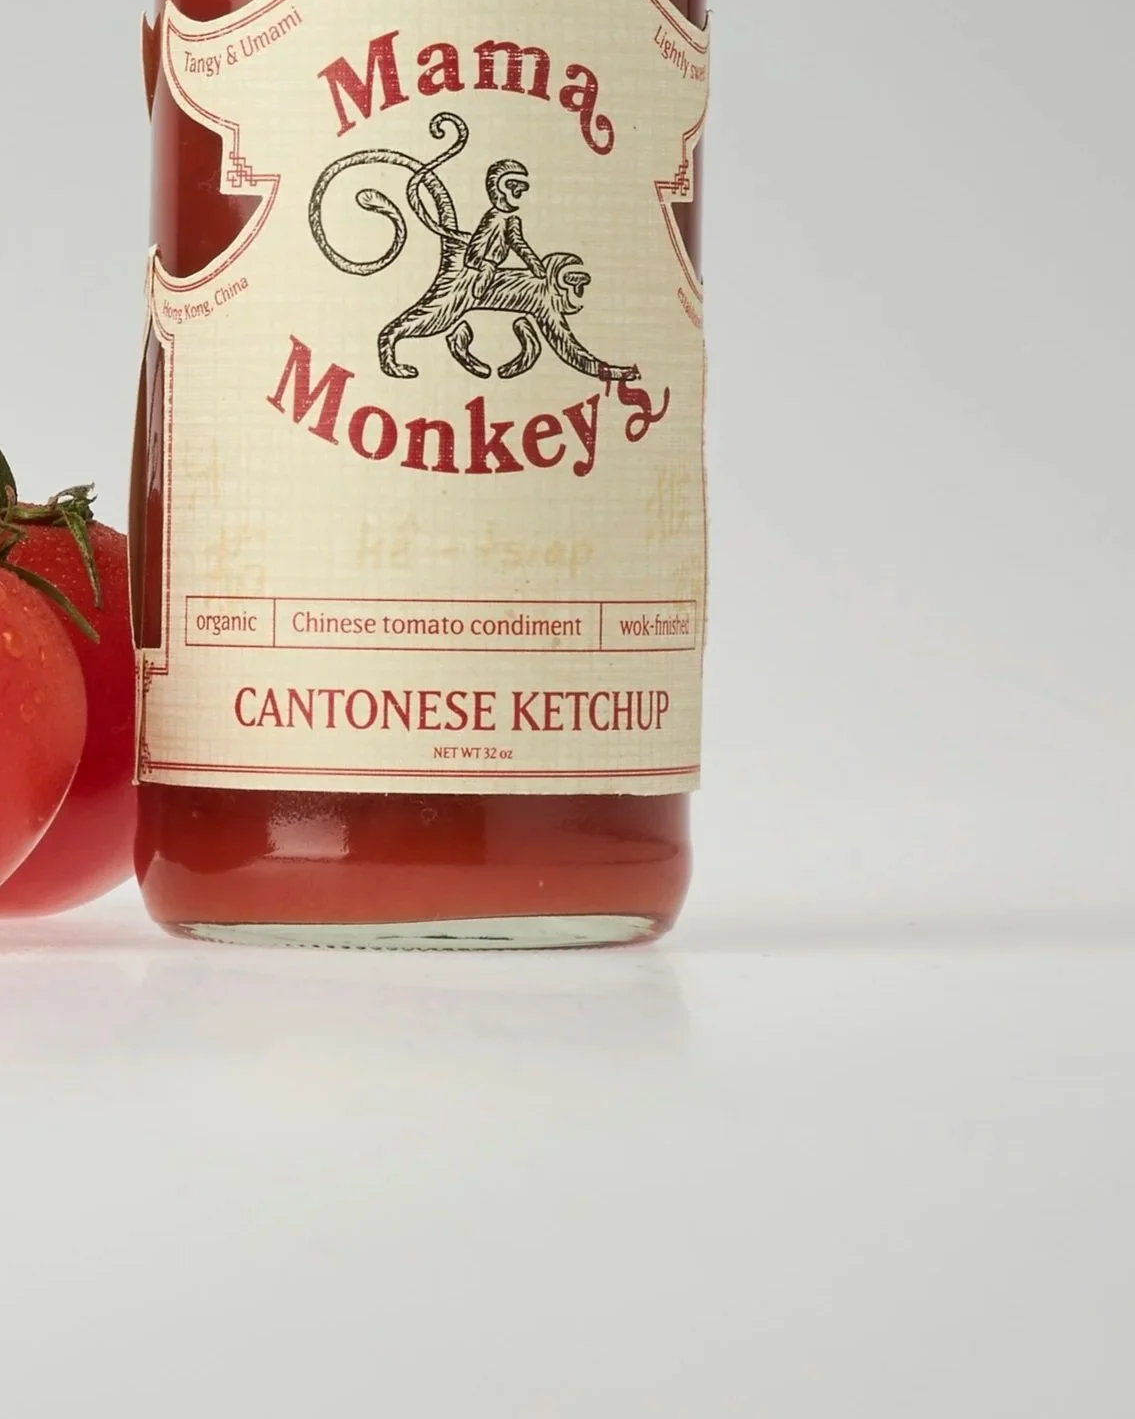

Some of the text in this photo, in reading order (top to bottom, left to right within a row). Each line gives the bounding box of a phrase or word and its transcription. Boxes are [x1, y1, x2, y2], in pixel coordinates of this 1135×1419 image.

[184, 5, 303, 77] Tangy & Umami
[654, 24, 690, 79] Lightly
[317, 29, 615, 156] Mama
[162, 277, 249, 325] Hong Kong, China
[266, 334, 670, 478] Monkey's
[196, 610, 258, 635] organic
[292, 611, 582, 636] Chinese tomato condiment
[620, 613, 690, 636] wok-finished
[234, 686, 670, 733] CANTONESE KETCHUP
[433, 747, 513, 759] NET WT 32 oz
